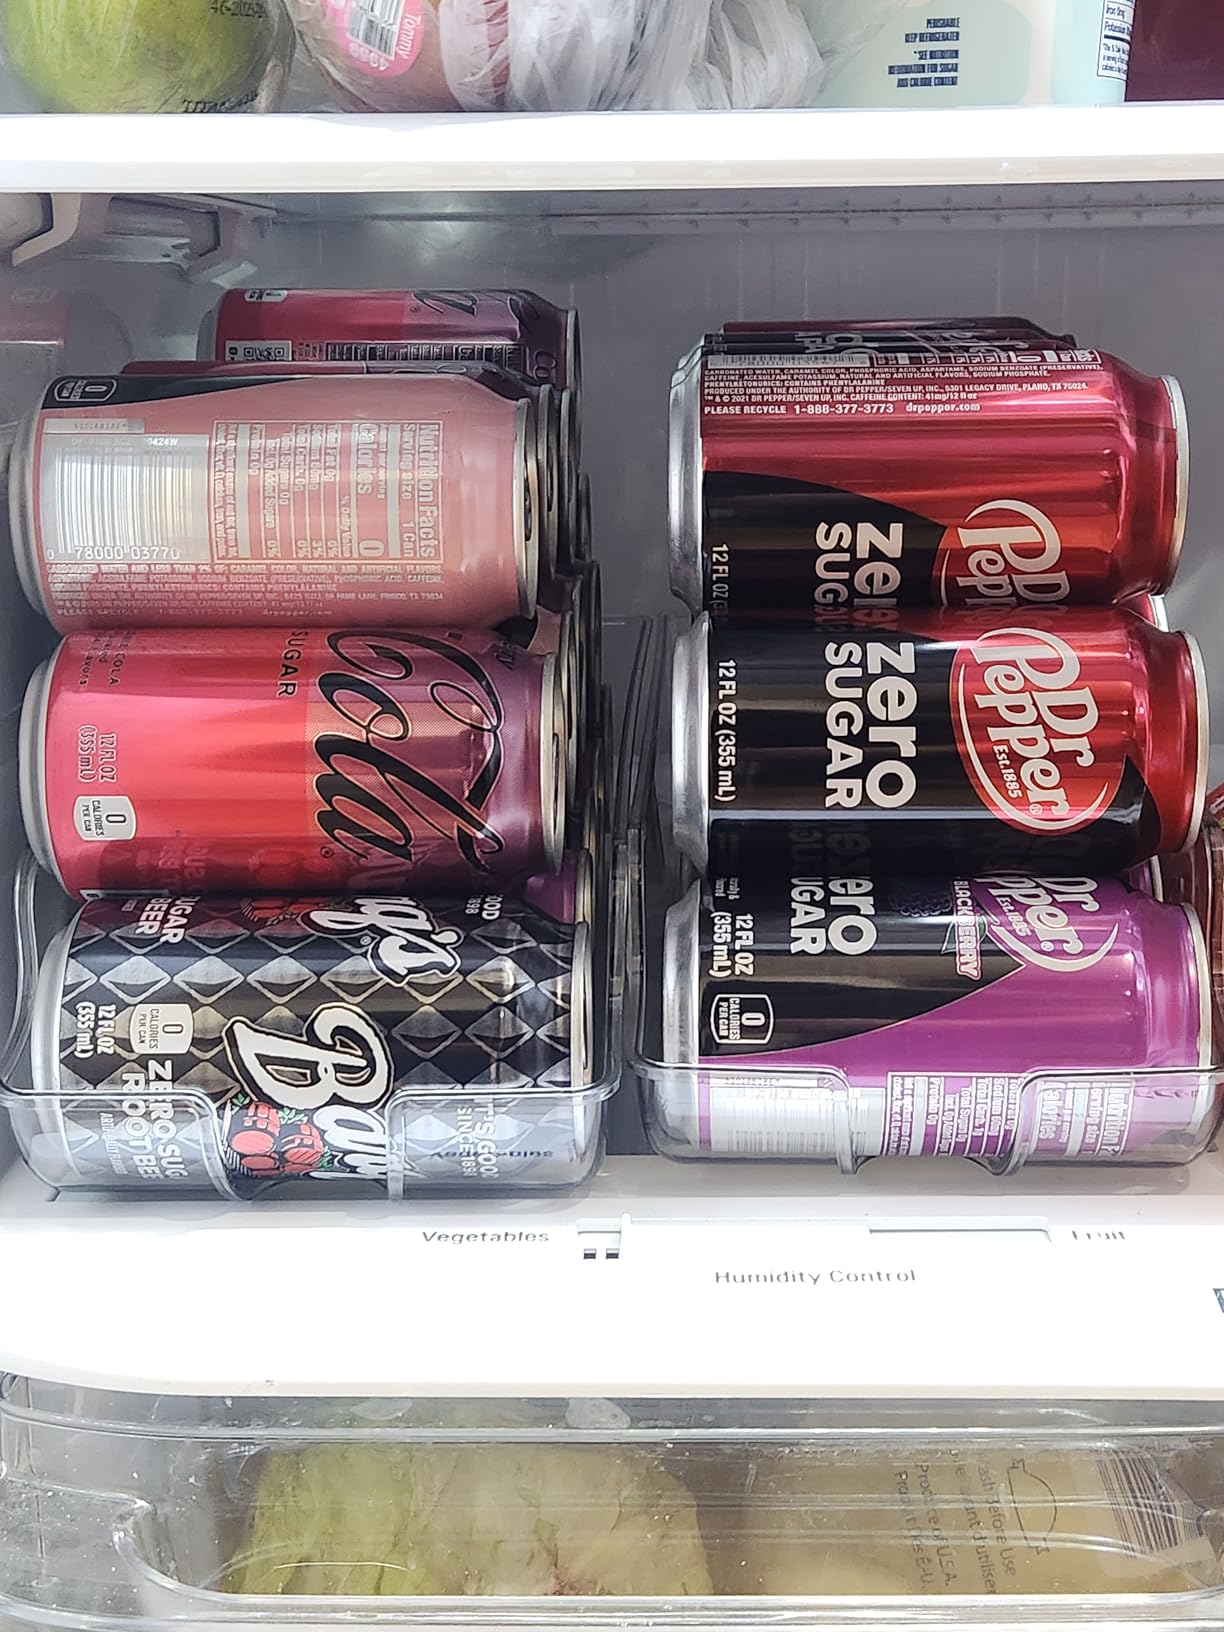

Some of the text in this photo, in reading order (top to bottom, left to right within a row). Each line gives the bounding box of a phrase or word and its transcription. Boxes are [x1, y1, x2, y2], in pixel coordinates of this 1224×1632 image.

[396, 13, 421, 60] Tommy
[704, 387, 745, 395] PRODUCED
[788, 386, 831, 394] AUTHORITY
[855, 385, 912, 393] PEPPER/SEVEN
[912, 385, 925, 393] UP,
[964, 383, 995, 391] LEGACY
[995, 383, 1022, 392] DRIVE,
[1022, 382, 1051, 392] PLANO,
[1051, 382, 1062, 390] TX
[730, 394, 749, 402] 2021
[763, 394, 820, 402] PEPPER/SEVEN
[820, 394, 833, 402] UP,
[833, 394, 849, 402] INC.
[850, 393, 887, 401] CAFFEINE
[887, 393, 924, 401] CONTENT:
[823, 379, 885, 387] PHENYLALANINE
[704, 402, 981, 414] PLEASE RECYCLE 1-888-377-3773 drpepper.com
[400, 423, 416, 470] Serving
[356, 423, 385, 557] Calories 0
[418, 423, 440, 558] Nutrition Facts
[403, 520, 415, 529] 1
[75, 546, 123, 560] 78000
[327, 539, 339, 558] 0%
[403, 533, 415, 558] Can
[955, 498, 1063, 607] Pep
[711, 543, 729, 599] 12 FL OZ
[713, 659, 738, 802] 12 FL OZ (355 mL)
[823, 640, 865, 809] SUGAR
[864, 641, 919, 810] zero
[968, 626, 1082, 817] Pepper
[1030, 685, 1100, 769] Dr
[77, 724, 98, 784] (355 mL)
[98, 732, 118, 784] 12 FL OZ
[81, 803, 92, 820] PER
[91, 798, 105, 837] CALORIES
[104, 812, 128, 825] 0
[134, 896, 174, 935] BEER
[709, 910, 733, 945] (355
[734, 912, 755, 930] 12
[826, 876, 879, 956] ero
[952, 879, 981, 979] BLACKBERRY
[734, 930, 755, 951] FL
[708, 944, 733, 979] mL)
[734, 951, 756, 977] OZ
[75, 1000, 97, 1059] (355 mL)
[96, 1003, 117, 1055] 12 FL OZ
[138, 1012, 148, 1045] PER CAN
[148, 1007, 160, 1050] CALORIES
[161, 1022, 184, 1035] 0
[718, 1000, 729, 1037] PER CAN
[728, 997, 741, 1041] CALORIES
[740, 1011, 766, 1027] 0
[147, 1058, 177, 1140] ZERO
[927, 1077, 941, 1114] Protein
[960, 1086, 973, 1108] Total
[975, 1077, 990, 1103] Total
[991, 1077, 1006, 1115] Sodium
[120, 1072, 153, 1154] ROOT
[456, 1105, 475, 1155] SINCE
[421, 1230, 550, 1245] Vegetables
[714, 1268, 917, 1286] Humidity Control
[999, 1546, 1017, 1577] Use
